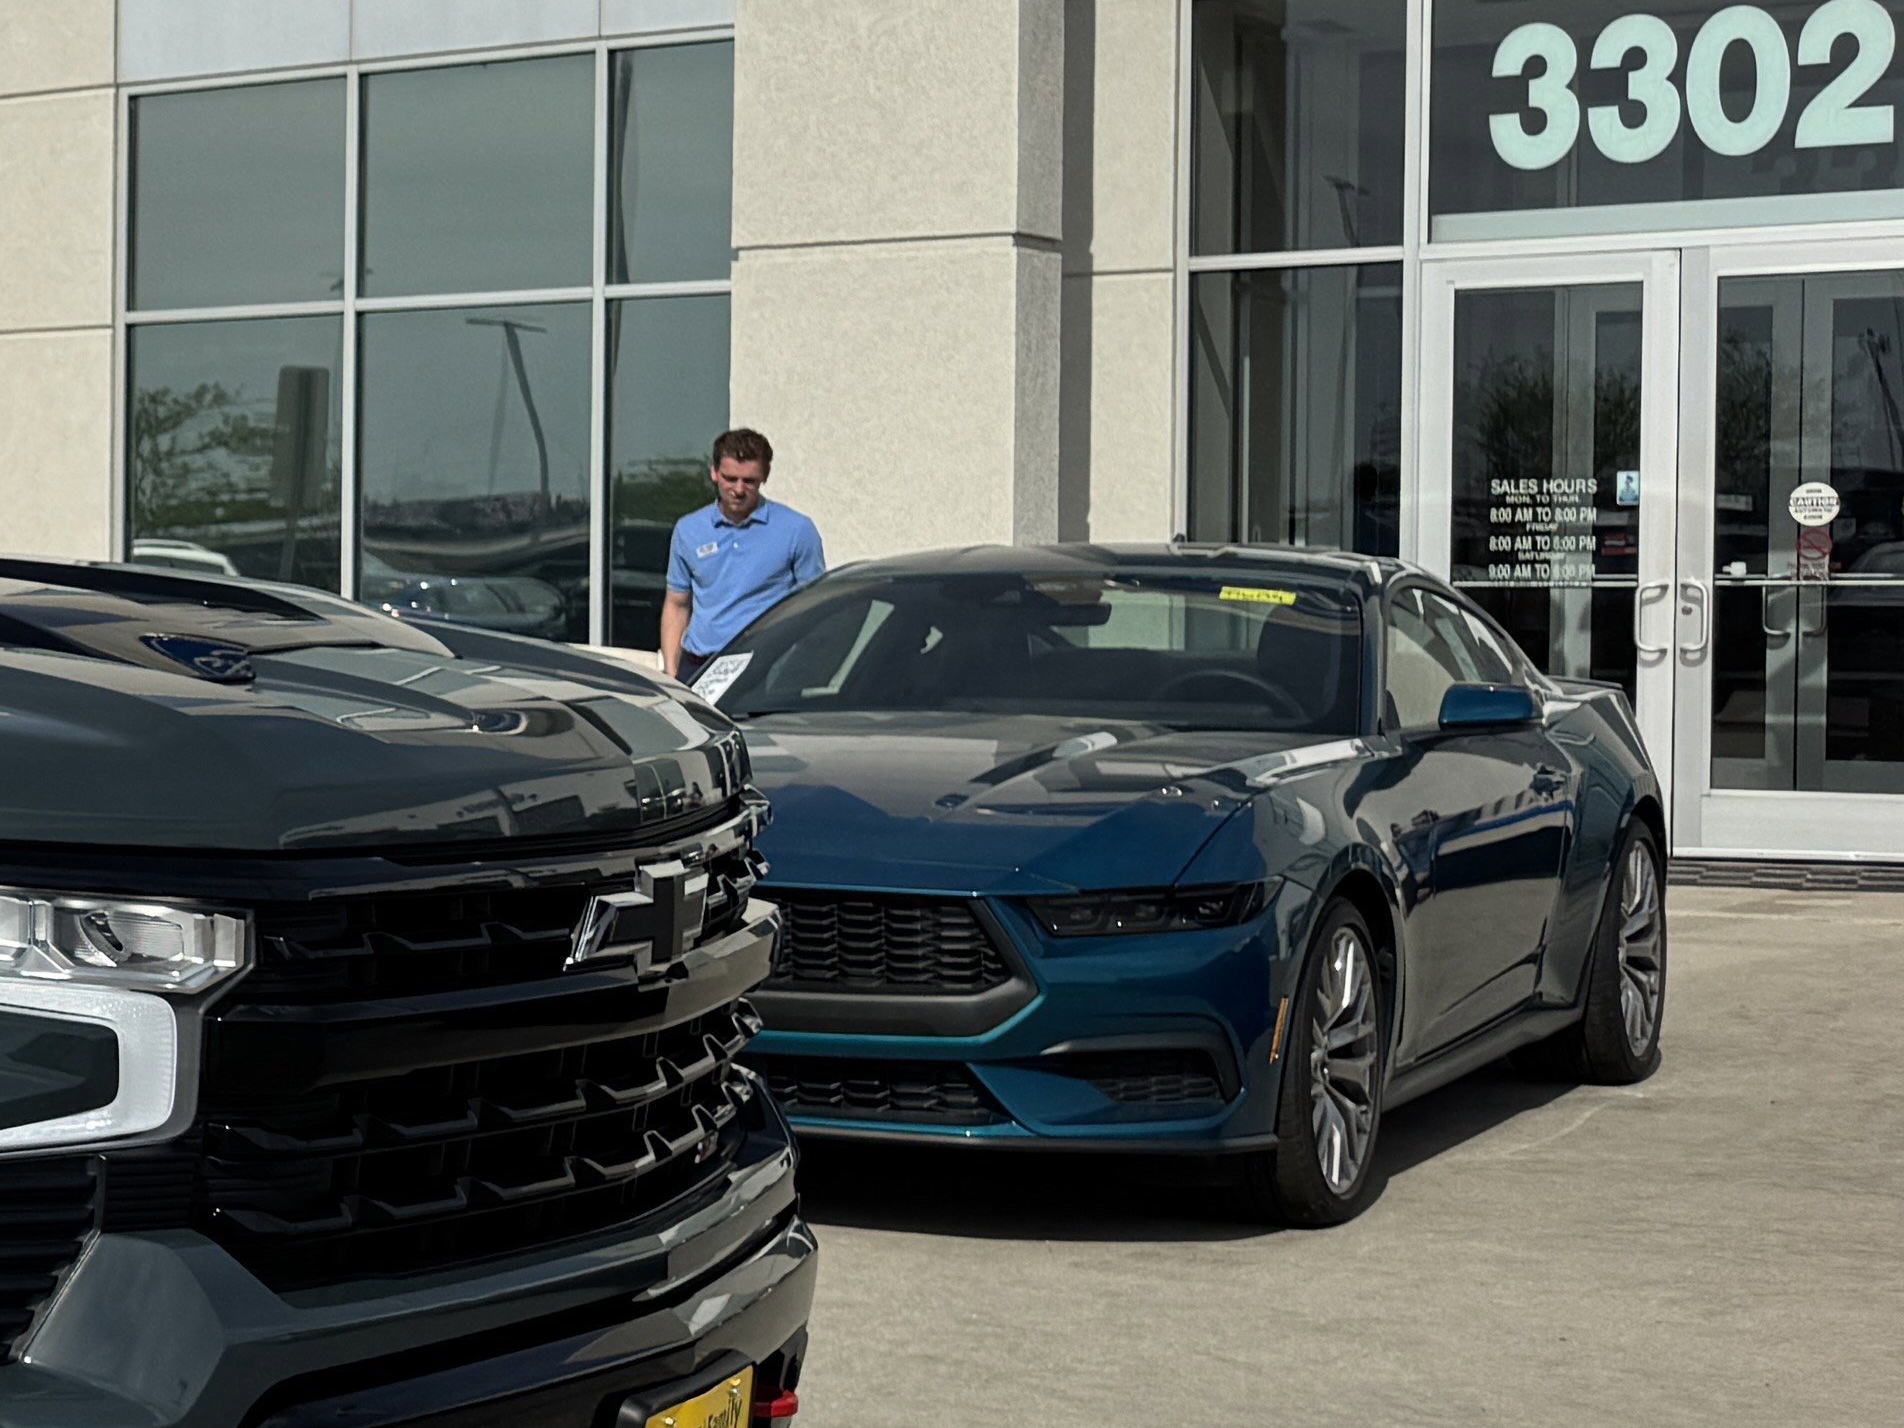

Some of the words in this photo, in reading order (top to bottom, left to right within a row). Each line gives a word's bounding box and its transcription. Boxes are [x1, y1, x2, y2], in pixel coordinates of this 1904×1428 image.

[1490, 479, 1538, 495] SALES
[1542, 478, 1598, 494] HOURS
[1536, 495, 1549, 504] TO
[1490, 507, 1512, 523] 8:00
[1515, 507, 1533, 522] AM
[1536, 507, 1552, 522] TO
[1580, 507, 1597, 522] PM
[1514, 536, 1532, 551] AM
[1535, 536, 1551, 550] TO
[1579, 536, 1597, 550] PM
[1513, 564, 1532, 579] AM
[1534, 564, 1550, 579] TO
[1578, 564, 1595, 579] PM
